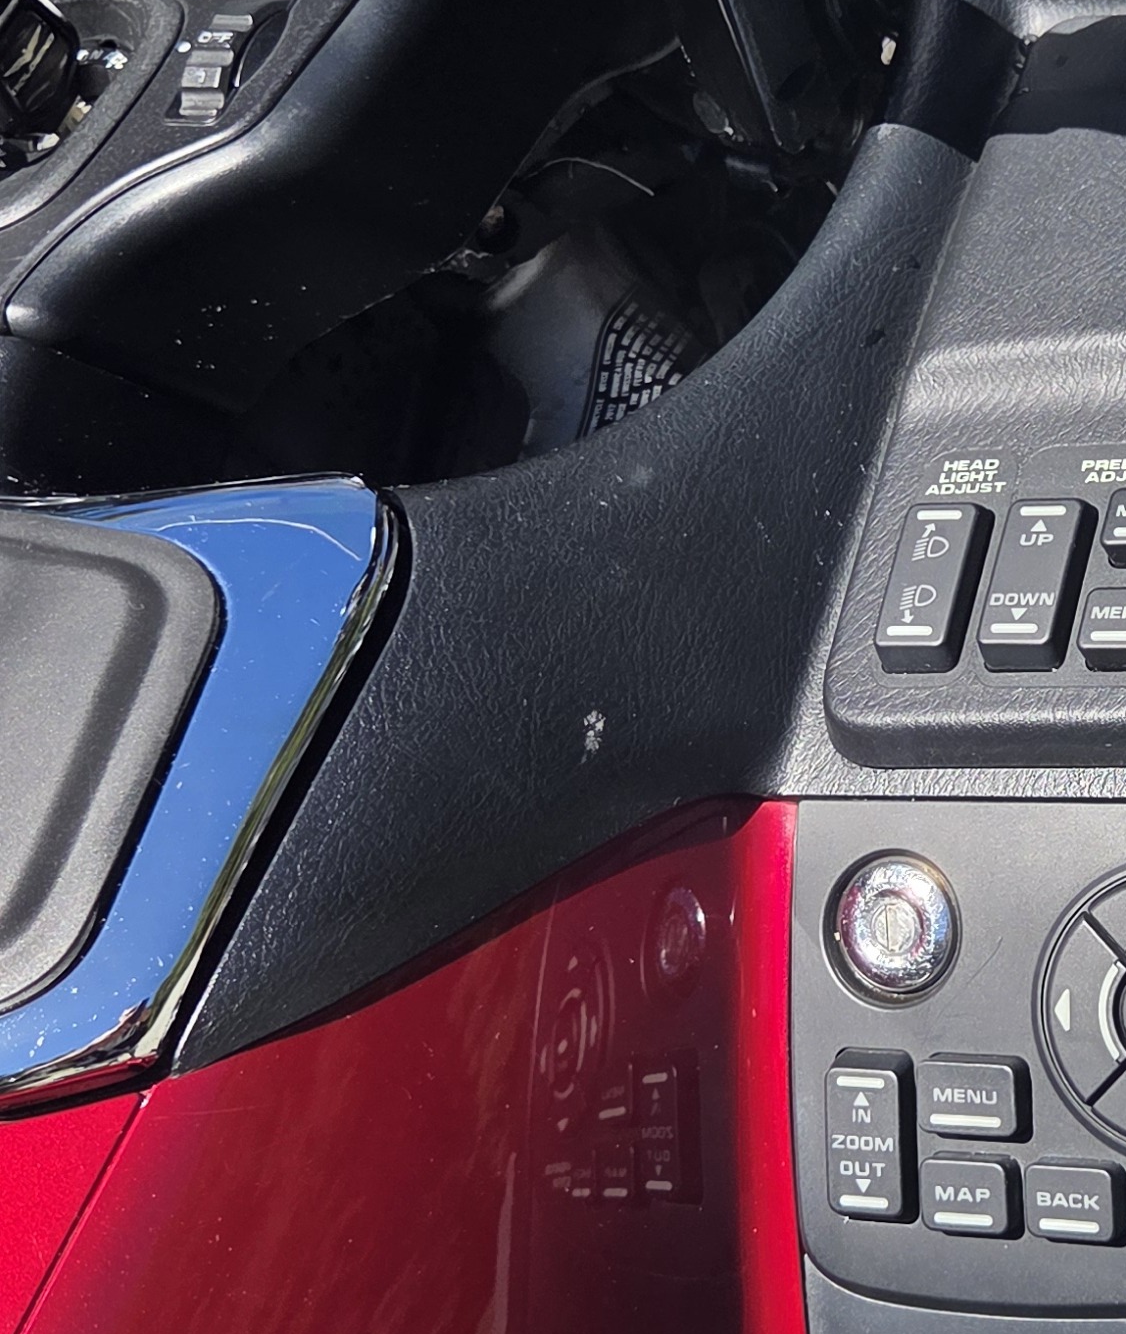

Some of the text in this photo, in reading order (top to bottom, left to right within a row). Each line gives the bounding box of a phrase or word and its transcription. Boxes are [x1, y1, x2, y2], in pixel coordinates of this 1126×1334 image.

[198, 31, 234, 43] OFF
[943, 459, 1000, 472] HEAD
[938, 471, 997, 483] LIGHT
[925, 482, 1006, 495] ADJUST
[1019, 533, 1054, 547] UP
[989, 592, 1054, 606] DOWN
[932, 1088, 998, 1105] MENU
[851, 1108, 872, 1123] IN
[831, 1134, 894, 1152] ZOOM
[839, 1161, 886, 1177] OUT
[934, 1186, 991, 1203] MAP
[1035, 1190, 1100, 1211] BACK
